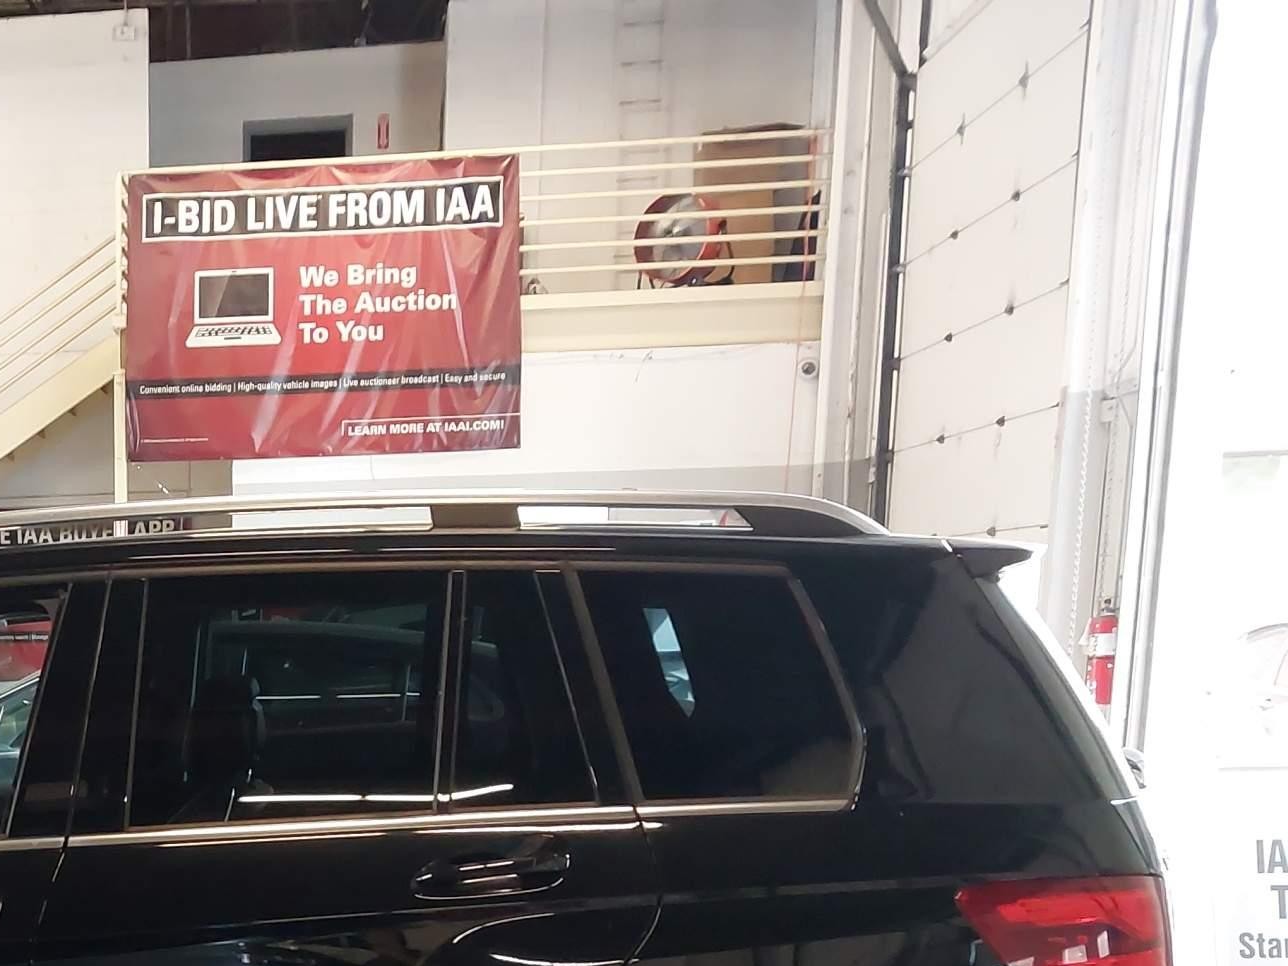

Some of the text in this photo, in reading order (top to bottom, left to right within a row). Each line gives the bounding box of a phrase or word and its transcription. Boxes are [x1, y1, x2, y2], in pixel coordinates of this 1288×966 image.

[152, 184, 495, 234] I-BID LIVE FROM IAA
[298, 263, 418, 290] We Bring
[298, 289, 458, 316] The Auction
[297, 320, 385, 344] To You
[181, 383, 204, 394] online
[205, 382, 232, 394] bidding
[310, 379, 338, 390] images
[401, 374, 440, 385] broadcast
[444, 373, 463, 384] Easy
[464, 372, 478, 382] and
[347, 424, 387, 437] LEARN
[390, 423, 425, 435] MORE
[425, 423, 442, 433] AT
[17, 528, 52, 545] IAA
[134, 519, 176, 535] APP
